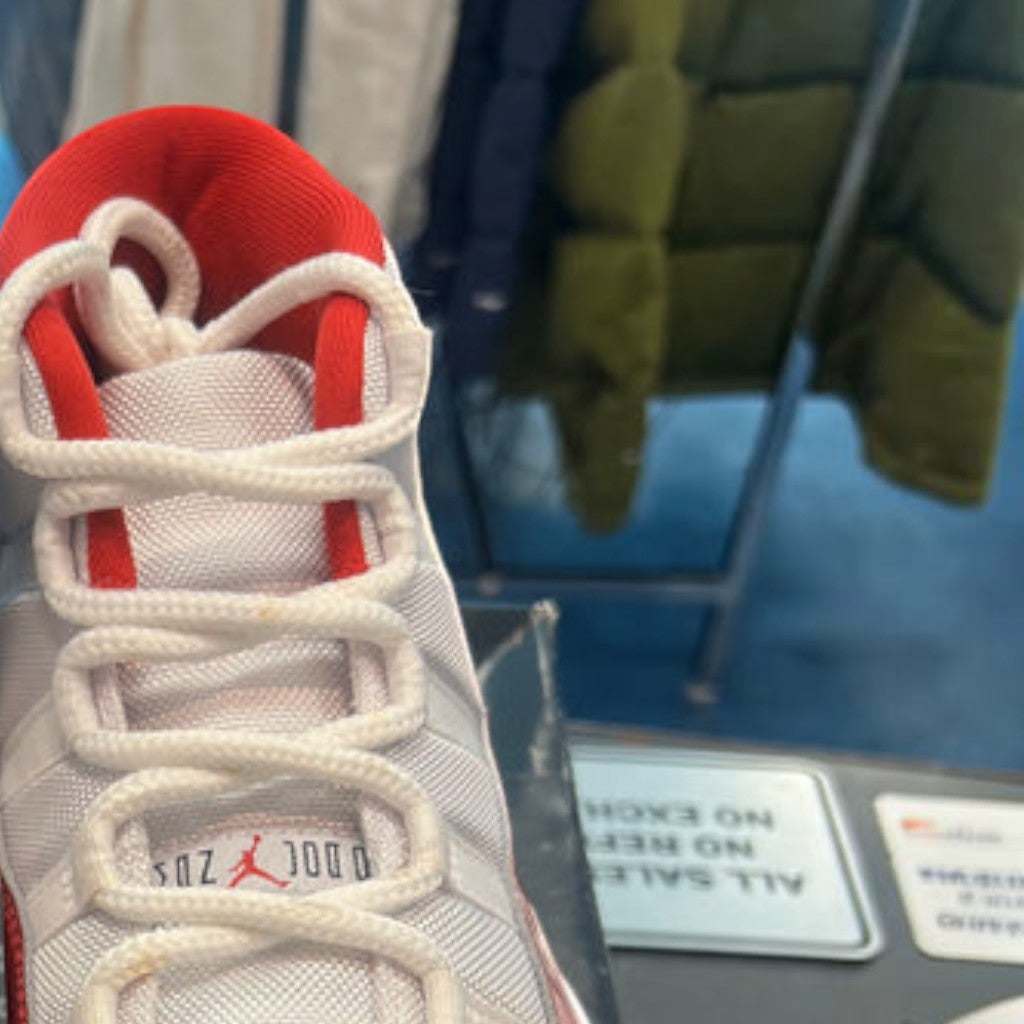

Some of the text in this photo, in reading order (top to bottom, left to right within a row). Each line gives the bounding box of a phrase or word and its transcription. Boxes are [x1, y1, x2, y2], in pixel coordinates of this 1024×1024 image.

[715, 807, 773, 829] NO
[587, 833, 753, 858] NO REF
[589, 865, 803, 894] ALL SALE
